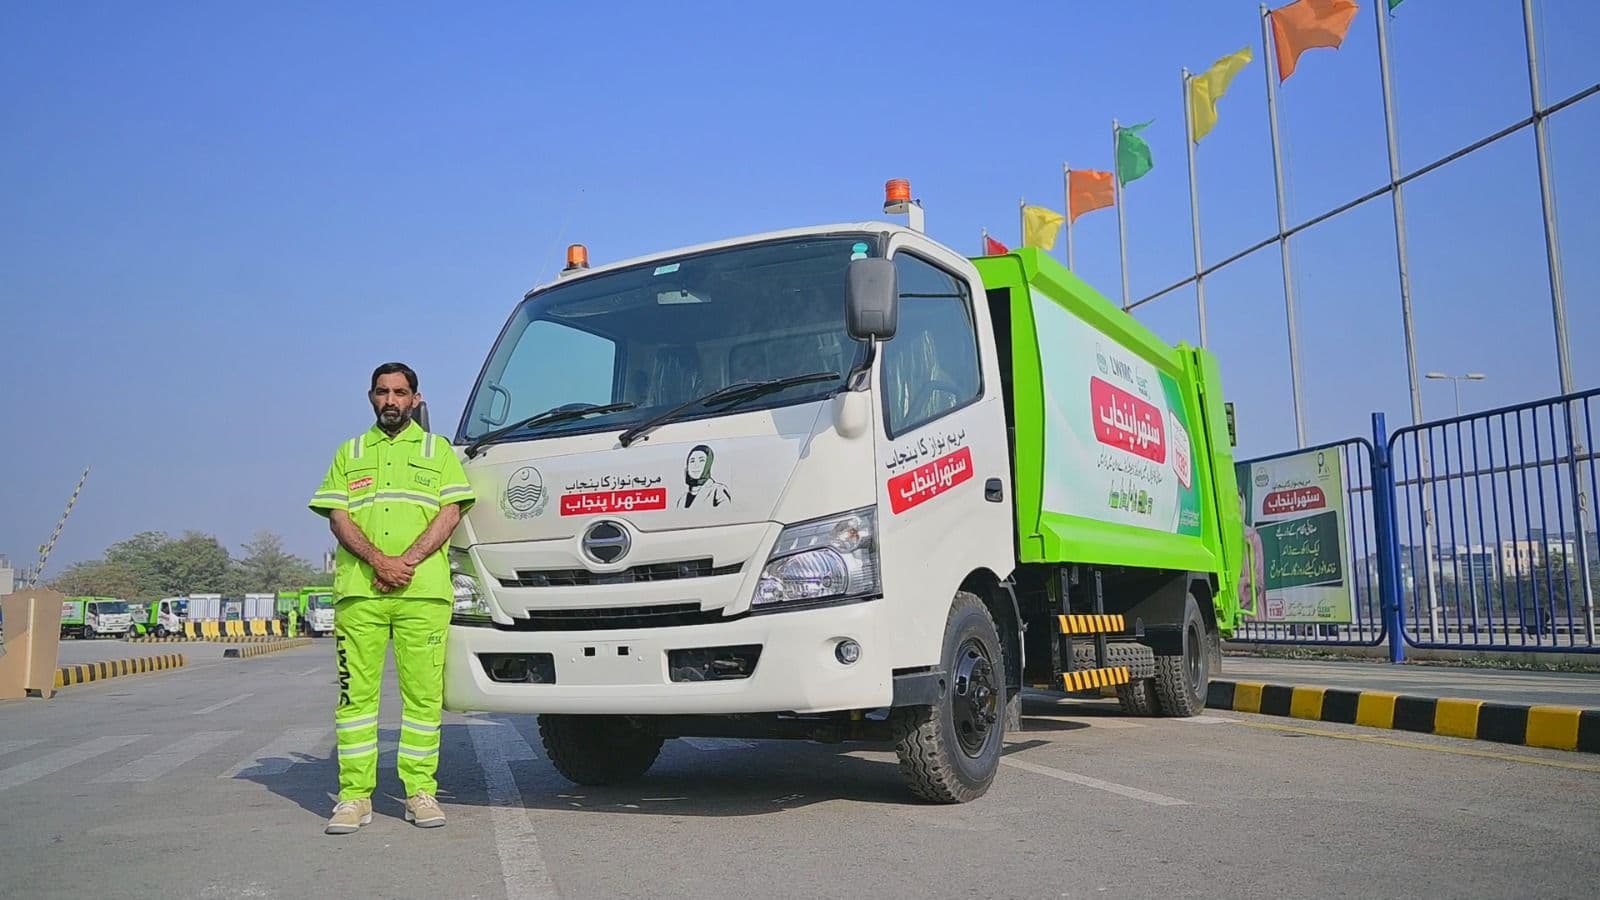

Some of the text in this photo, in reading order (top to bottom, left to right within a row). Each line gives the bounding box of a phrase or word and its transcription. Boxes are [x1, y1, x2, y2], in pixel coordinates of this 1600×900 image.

[1100, 394, 1136, 449] پنجاب
[917, 438, 928, 456] کا
[928, 431, 946, 457] نواز
[601, 475, 610, 488] کا
[611, 474, 631, 490] نواز
[632, 475, 662, 487] مریم
[900, 458, 966, 502] ستھرا پنجاب
[566, 492, 660, 512] ستھرا پنجاب
[1268, 494, 1295, 512] پنجاب
